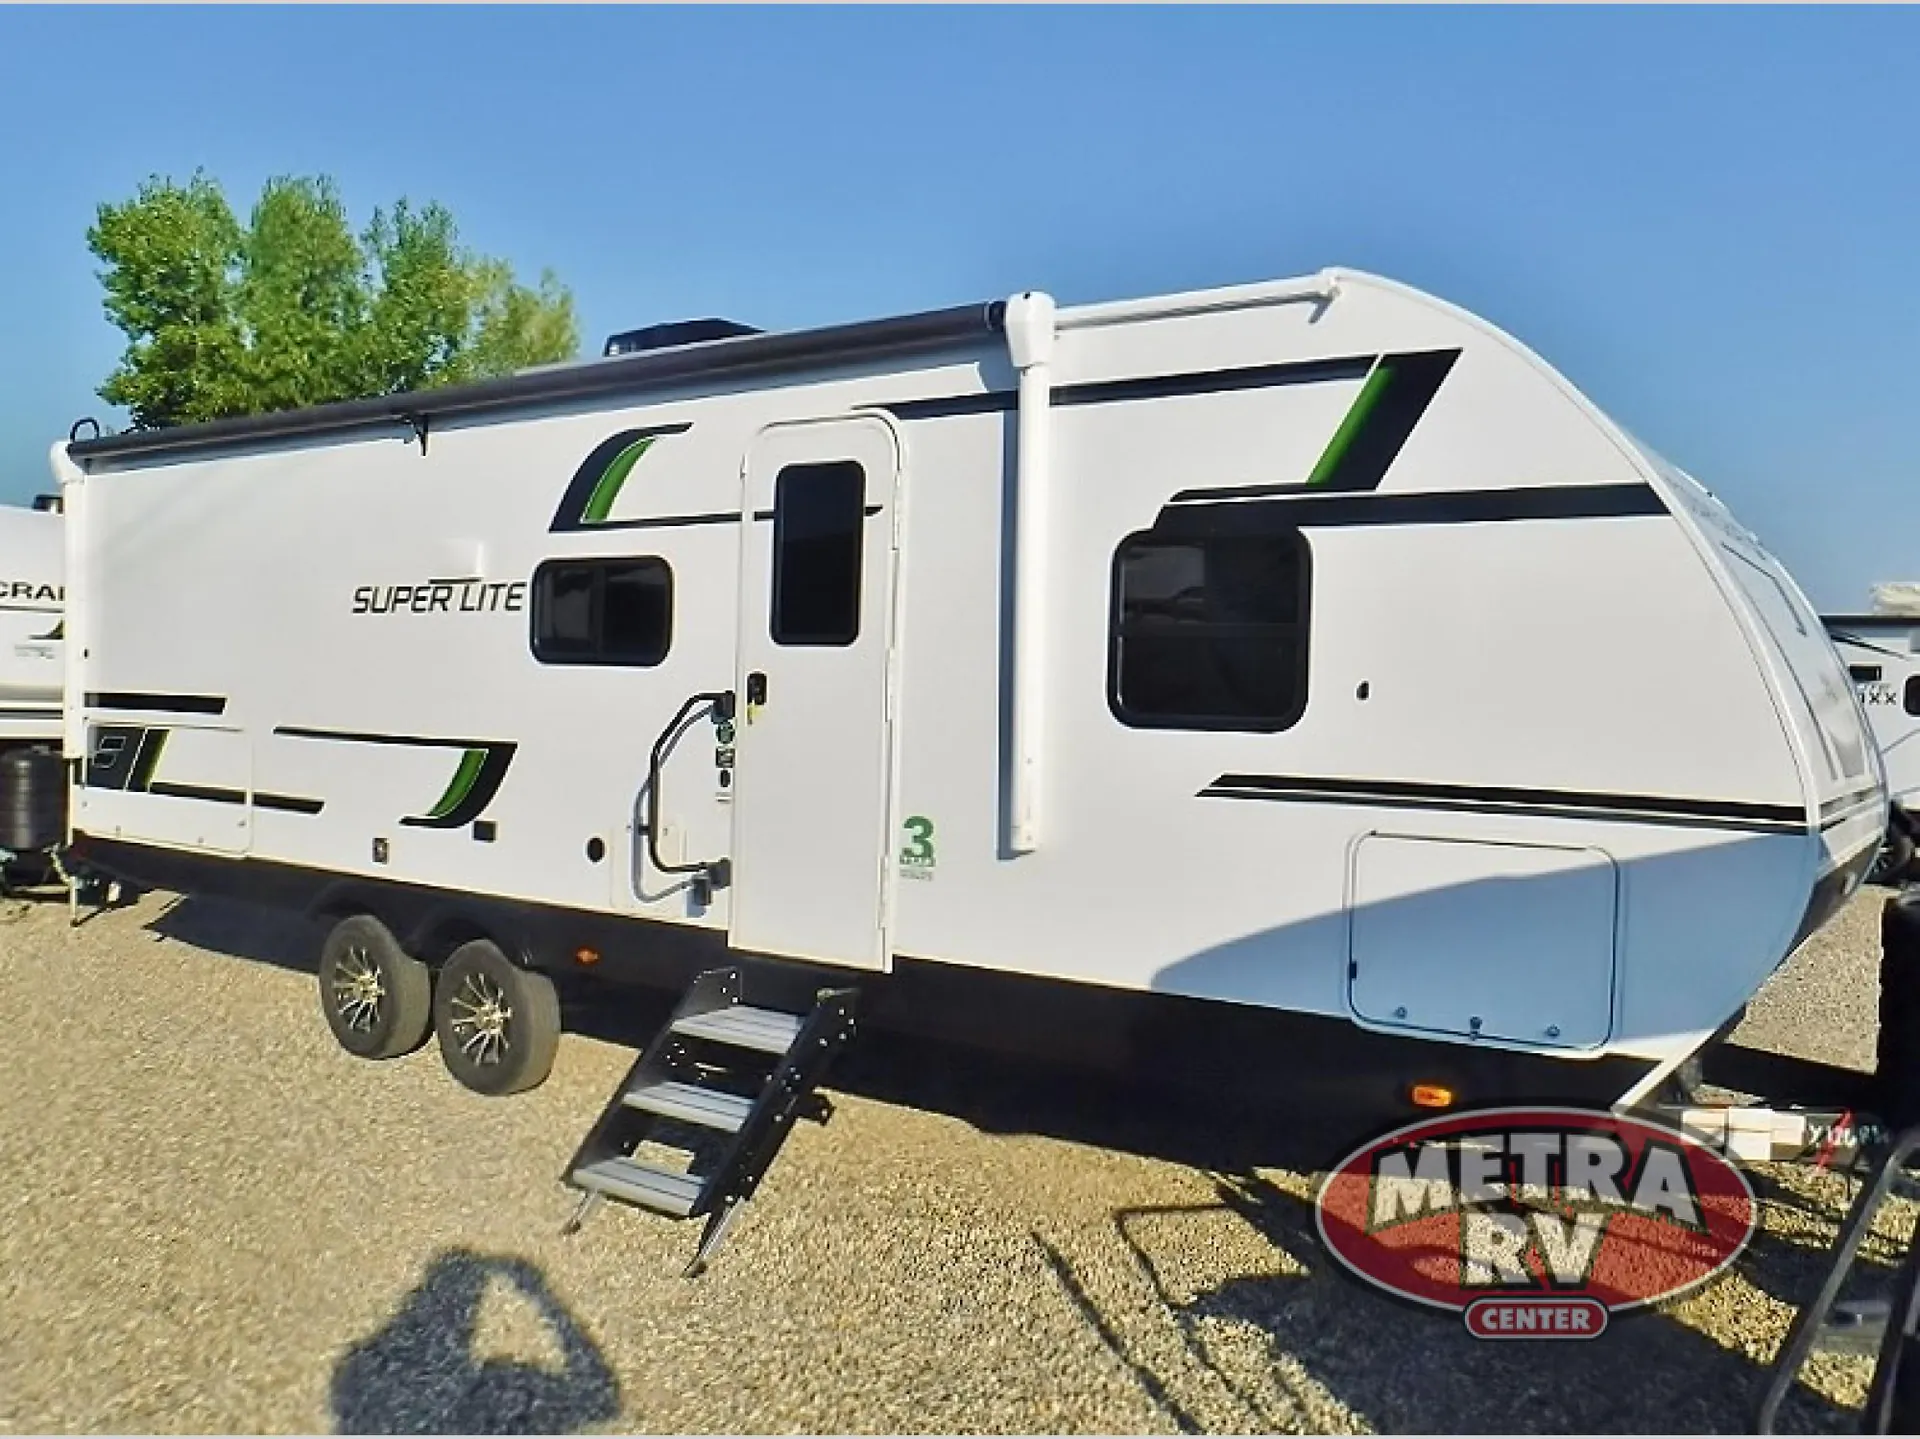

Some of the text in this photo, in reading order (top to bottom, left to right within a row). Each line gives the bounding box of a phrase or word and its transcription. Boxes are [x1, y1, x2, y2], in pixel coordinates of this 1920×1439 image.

[352, 581, 527, 614] SUPER LITE
[901, 815, 934, 857] 3
